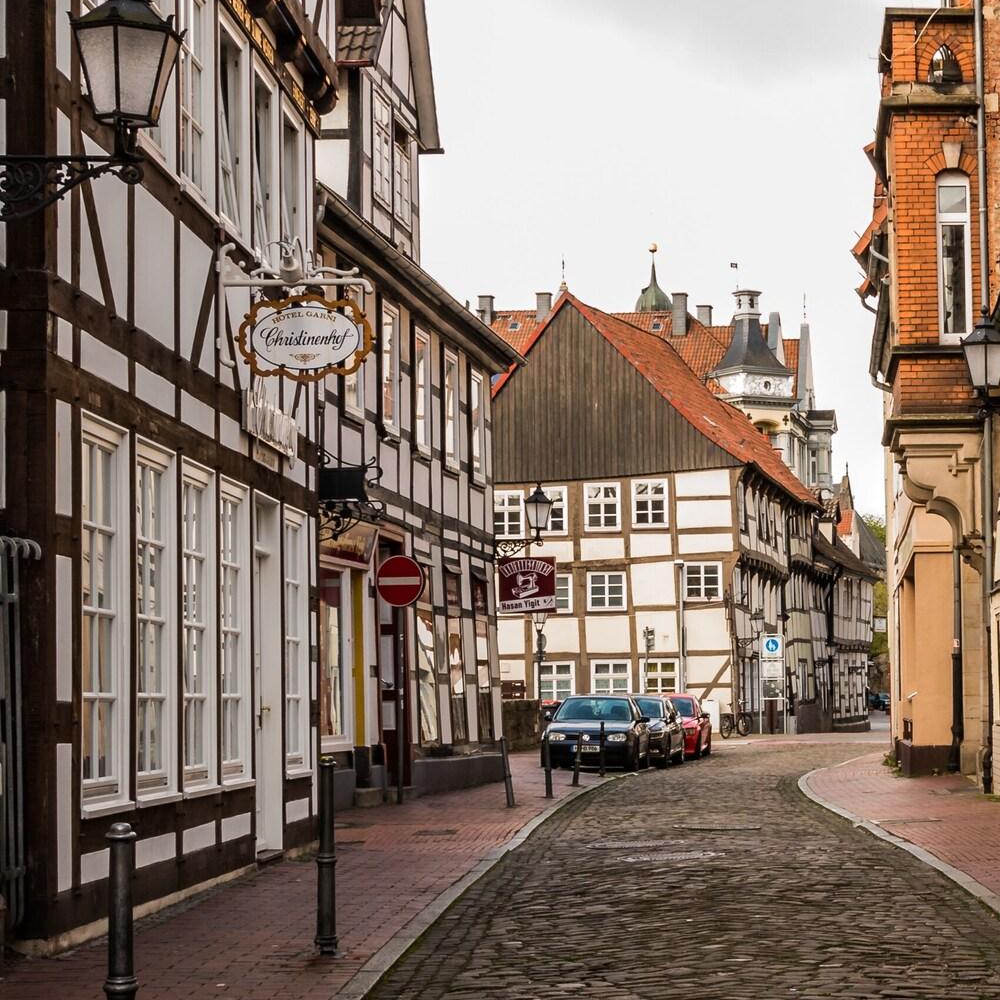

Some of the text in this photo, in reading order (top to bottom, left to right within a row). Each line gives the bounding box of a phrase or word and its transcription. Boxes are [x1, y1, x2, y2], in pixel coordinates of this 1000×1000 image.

[271, 310, 337, 325] HOTEL GARNI
[260, 327, 354, 353] Christinenhof
[501, 602, 523, 611] Hasan
